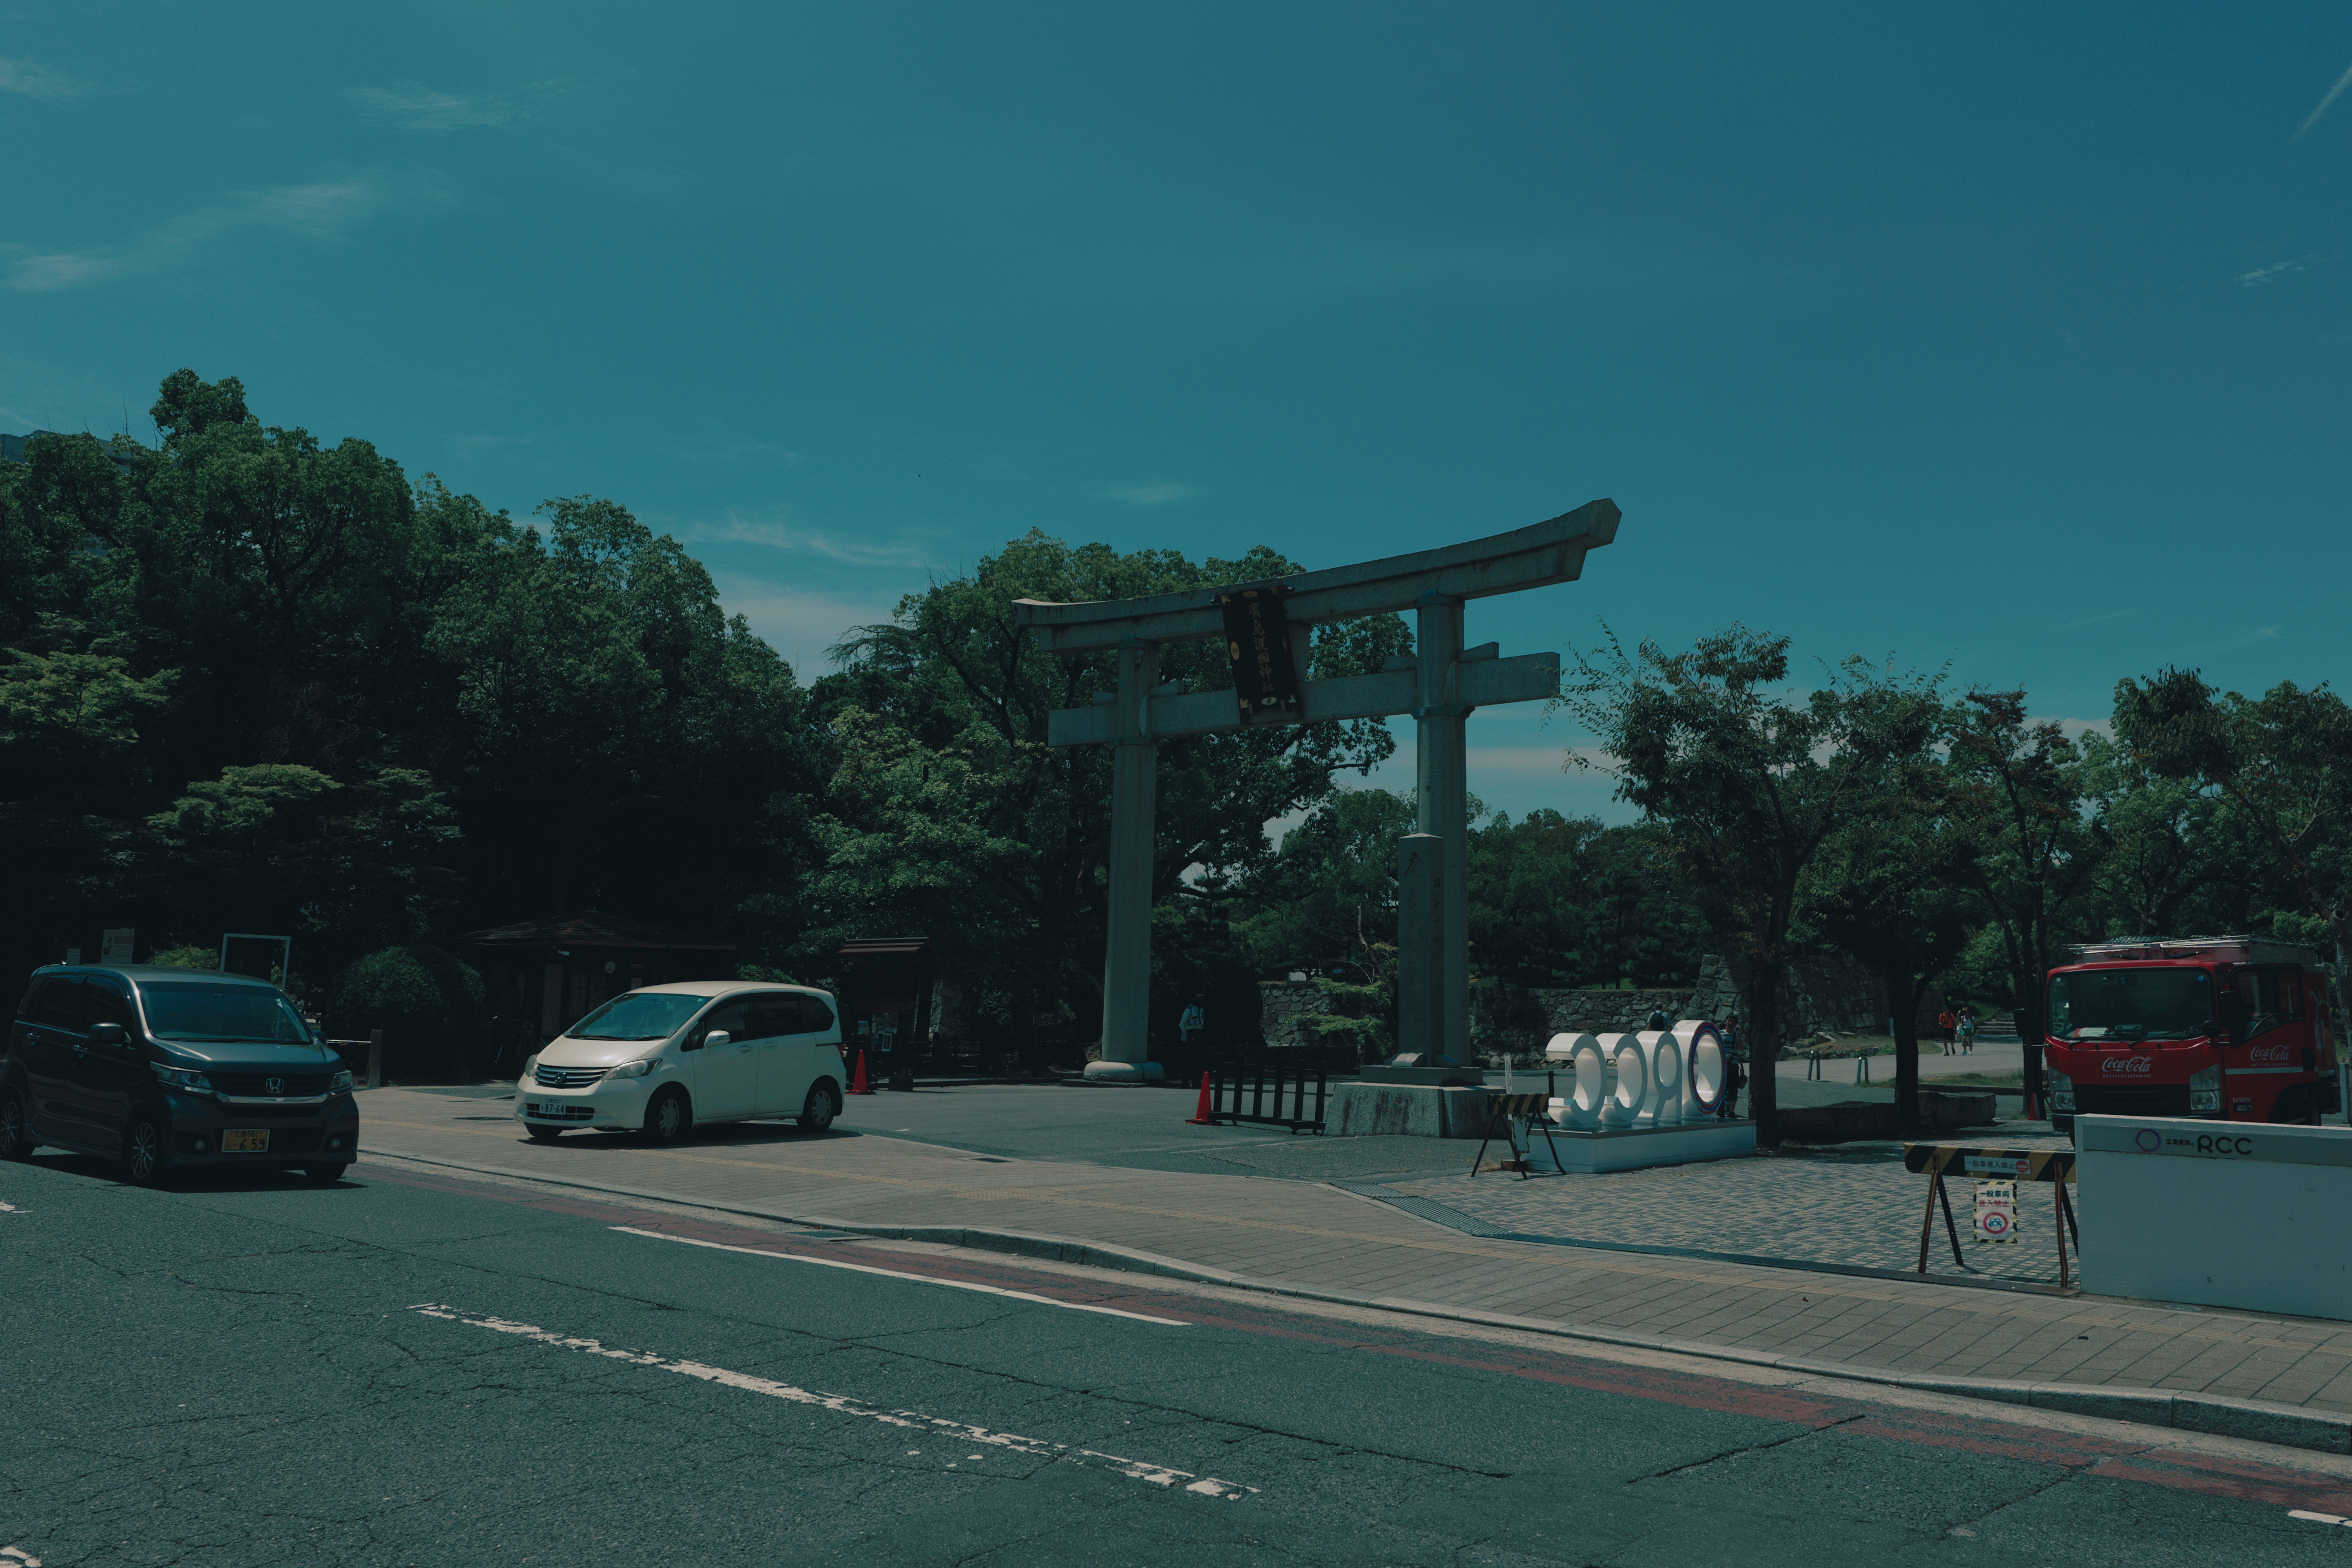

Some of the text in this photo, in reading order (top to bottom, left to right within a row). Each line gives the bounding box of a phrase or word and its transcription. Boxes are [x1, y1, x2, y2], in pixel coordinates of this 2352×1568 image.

[1248, 602, 1275, 693] 廣島護國神社
[2250, 1045, 2291, 1061] Coca-Cola
[2102, 1056, 2153, 1072] Coca-Cola
[545, 1104, 564, 1113] 87-64
[2197, 1135, 2252, 1155] RCC
[1965, 1160, 2016, 1169] 一般車進入禁止
